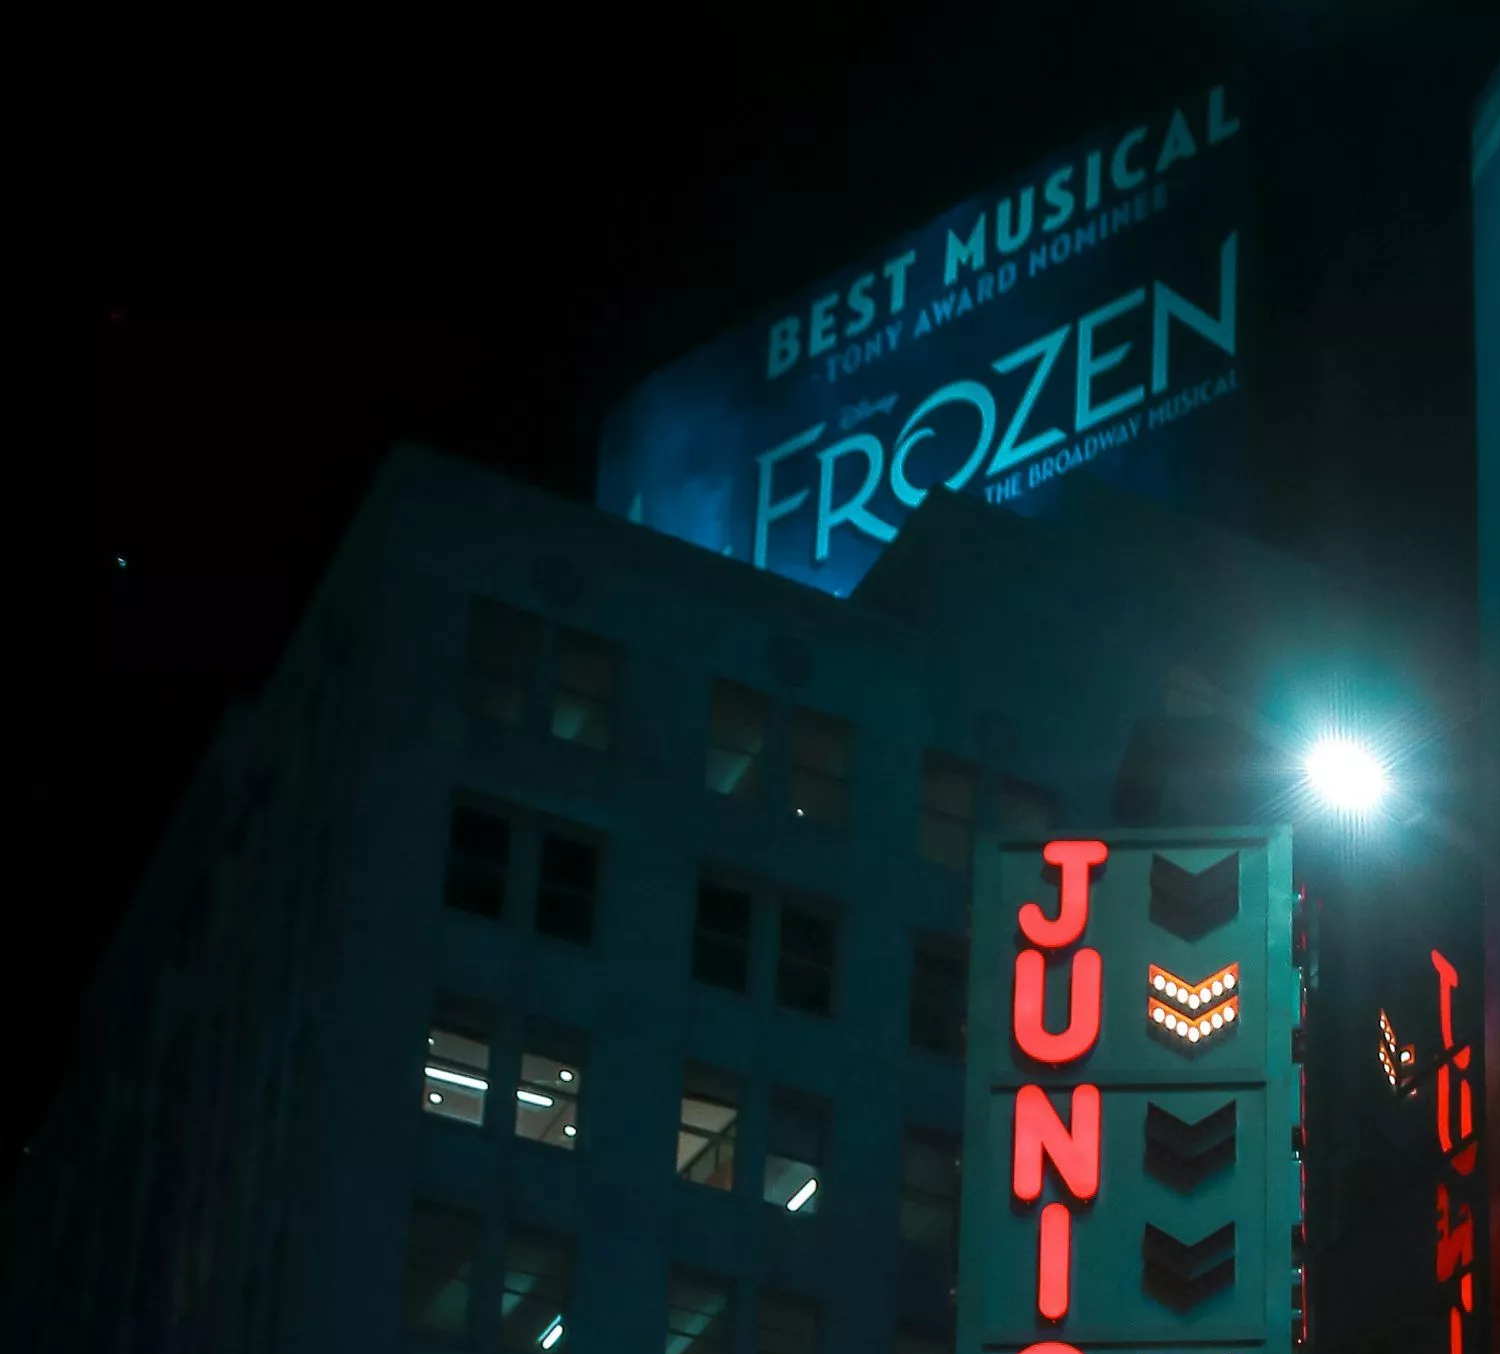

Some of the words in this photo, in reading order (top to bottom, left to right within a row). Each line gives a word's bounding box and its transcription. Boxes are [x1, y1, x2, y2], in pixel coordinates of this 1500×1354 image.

[766, 248, 916, 380] BEST
[943, 83, 1241, 287] MUSICAL
[823, 318, 905, 385] TONY
[913, 261, 1018, 339] AWARD
[753, 229, 1240, 571] FROZEN
[984, 477, 1023, 504] THE
[1028, 417, 1140, 490] BROADWAY
[1148, 368, 1240, 431] MUSICAL
